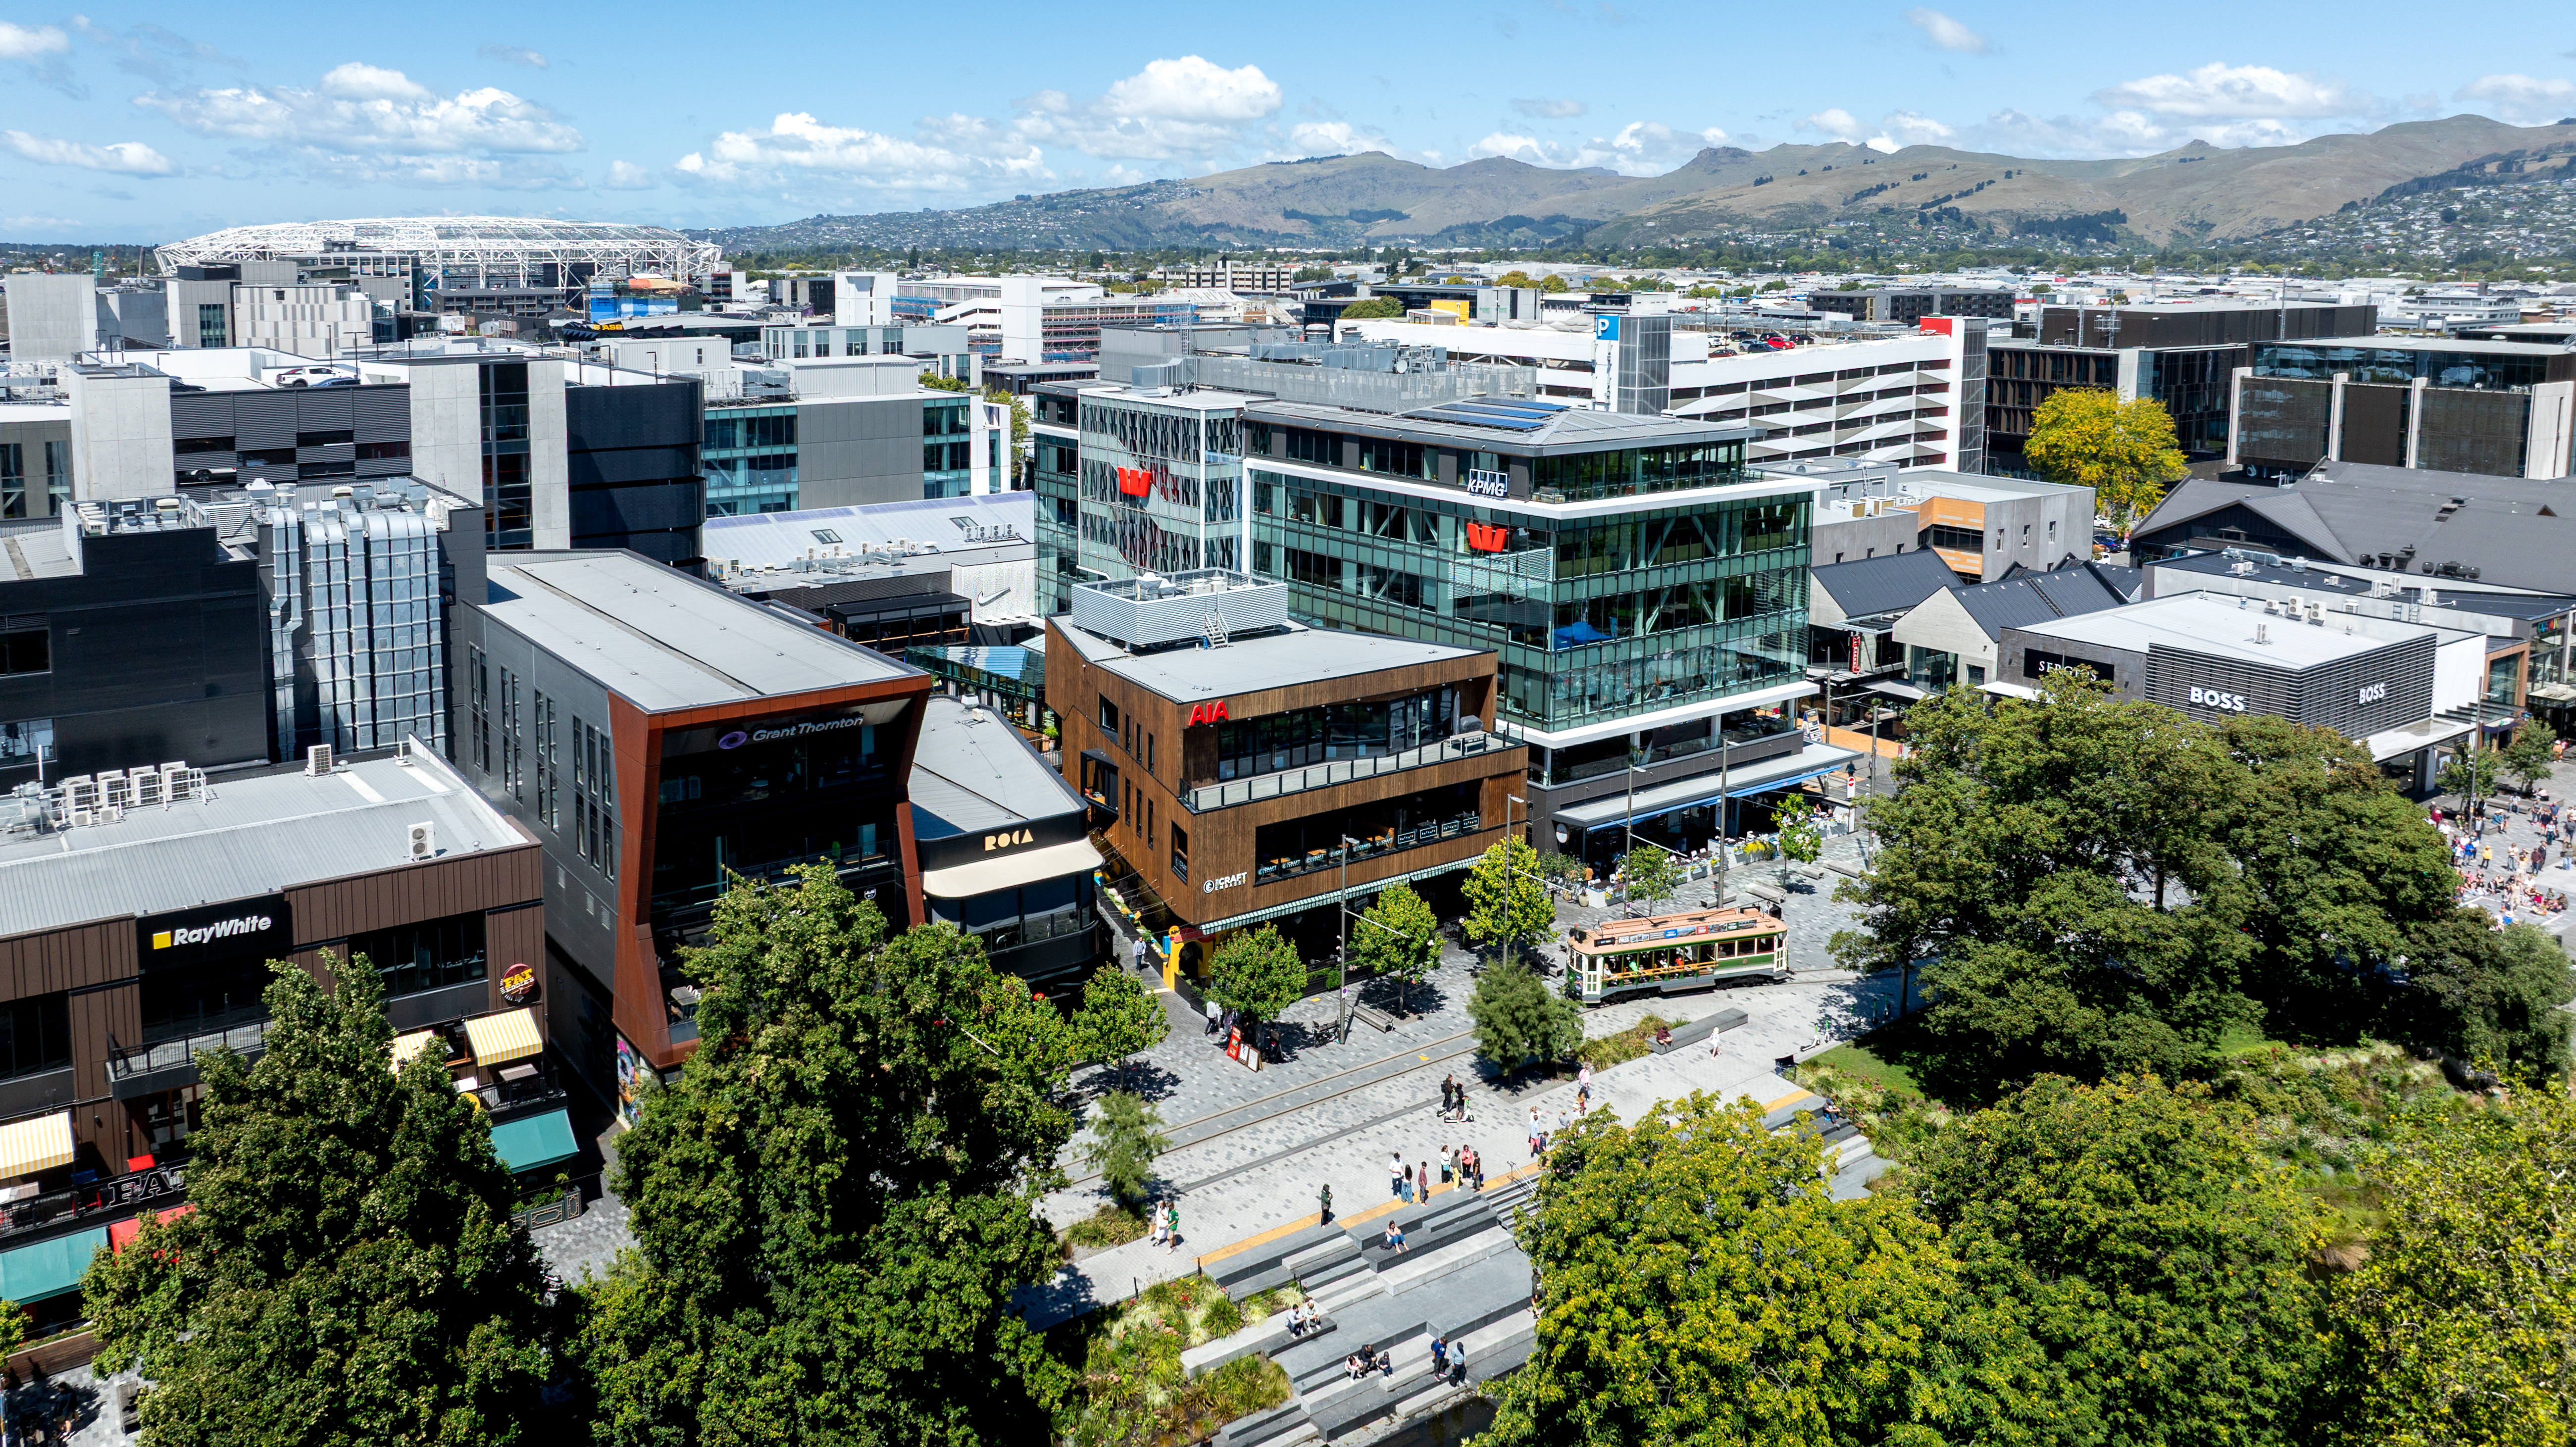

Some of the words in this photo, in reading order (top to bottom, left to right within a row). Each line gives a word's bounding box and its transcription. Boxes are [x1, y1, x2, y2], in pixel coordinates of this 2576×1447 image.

[1598, 318, 1609, 336] P
[1467, 479, 1506, 497] KPMG
[2190, 686, 2245, 711] BOSS
[2359, 683, 2385, 704] BOSS
[1188, 701, 1229, 726] AIA
[753, 726, 797, 741] Grant
[798, 717, 863, 735] Thornton
[985, 829, 1033, 851] ROCA
[1219, 872, 1247, 886] CRAFT
[503, 968, 532, 988] FAT
[1385, 1254, 1408, 1267] FLOTILLA
[1416, 1244, 1435, 1254] LEAVES
